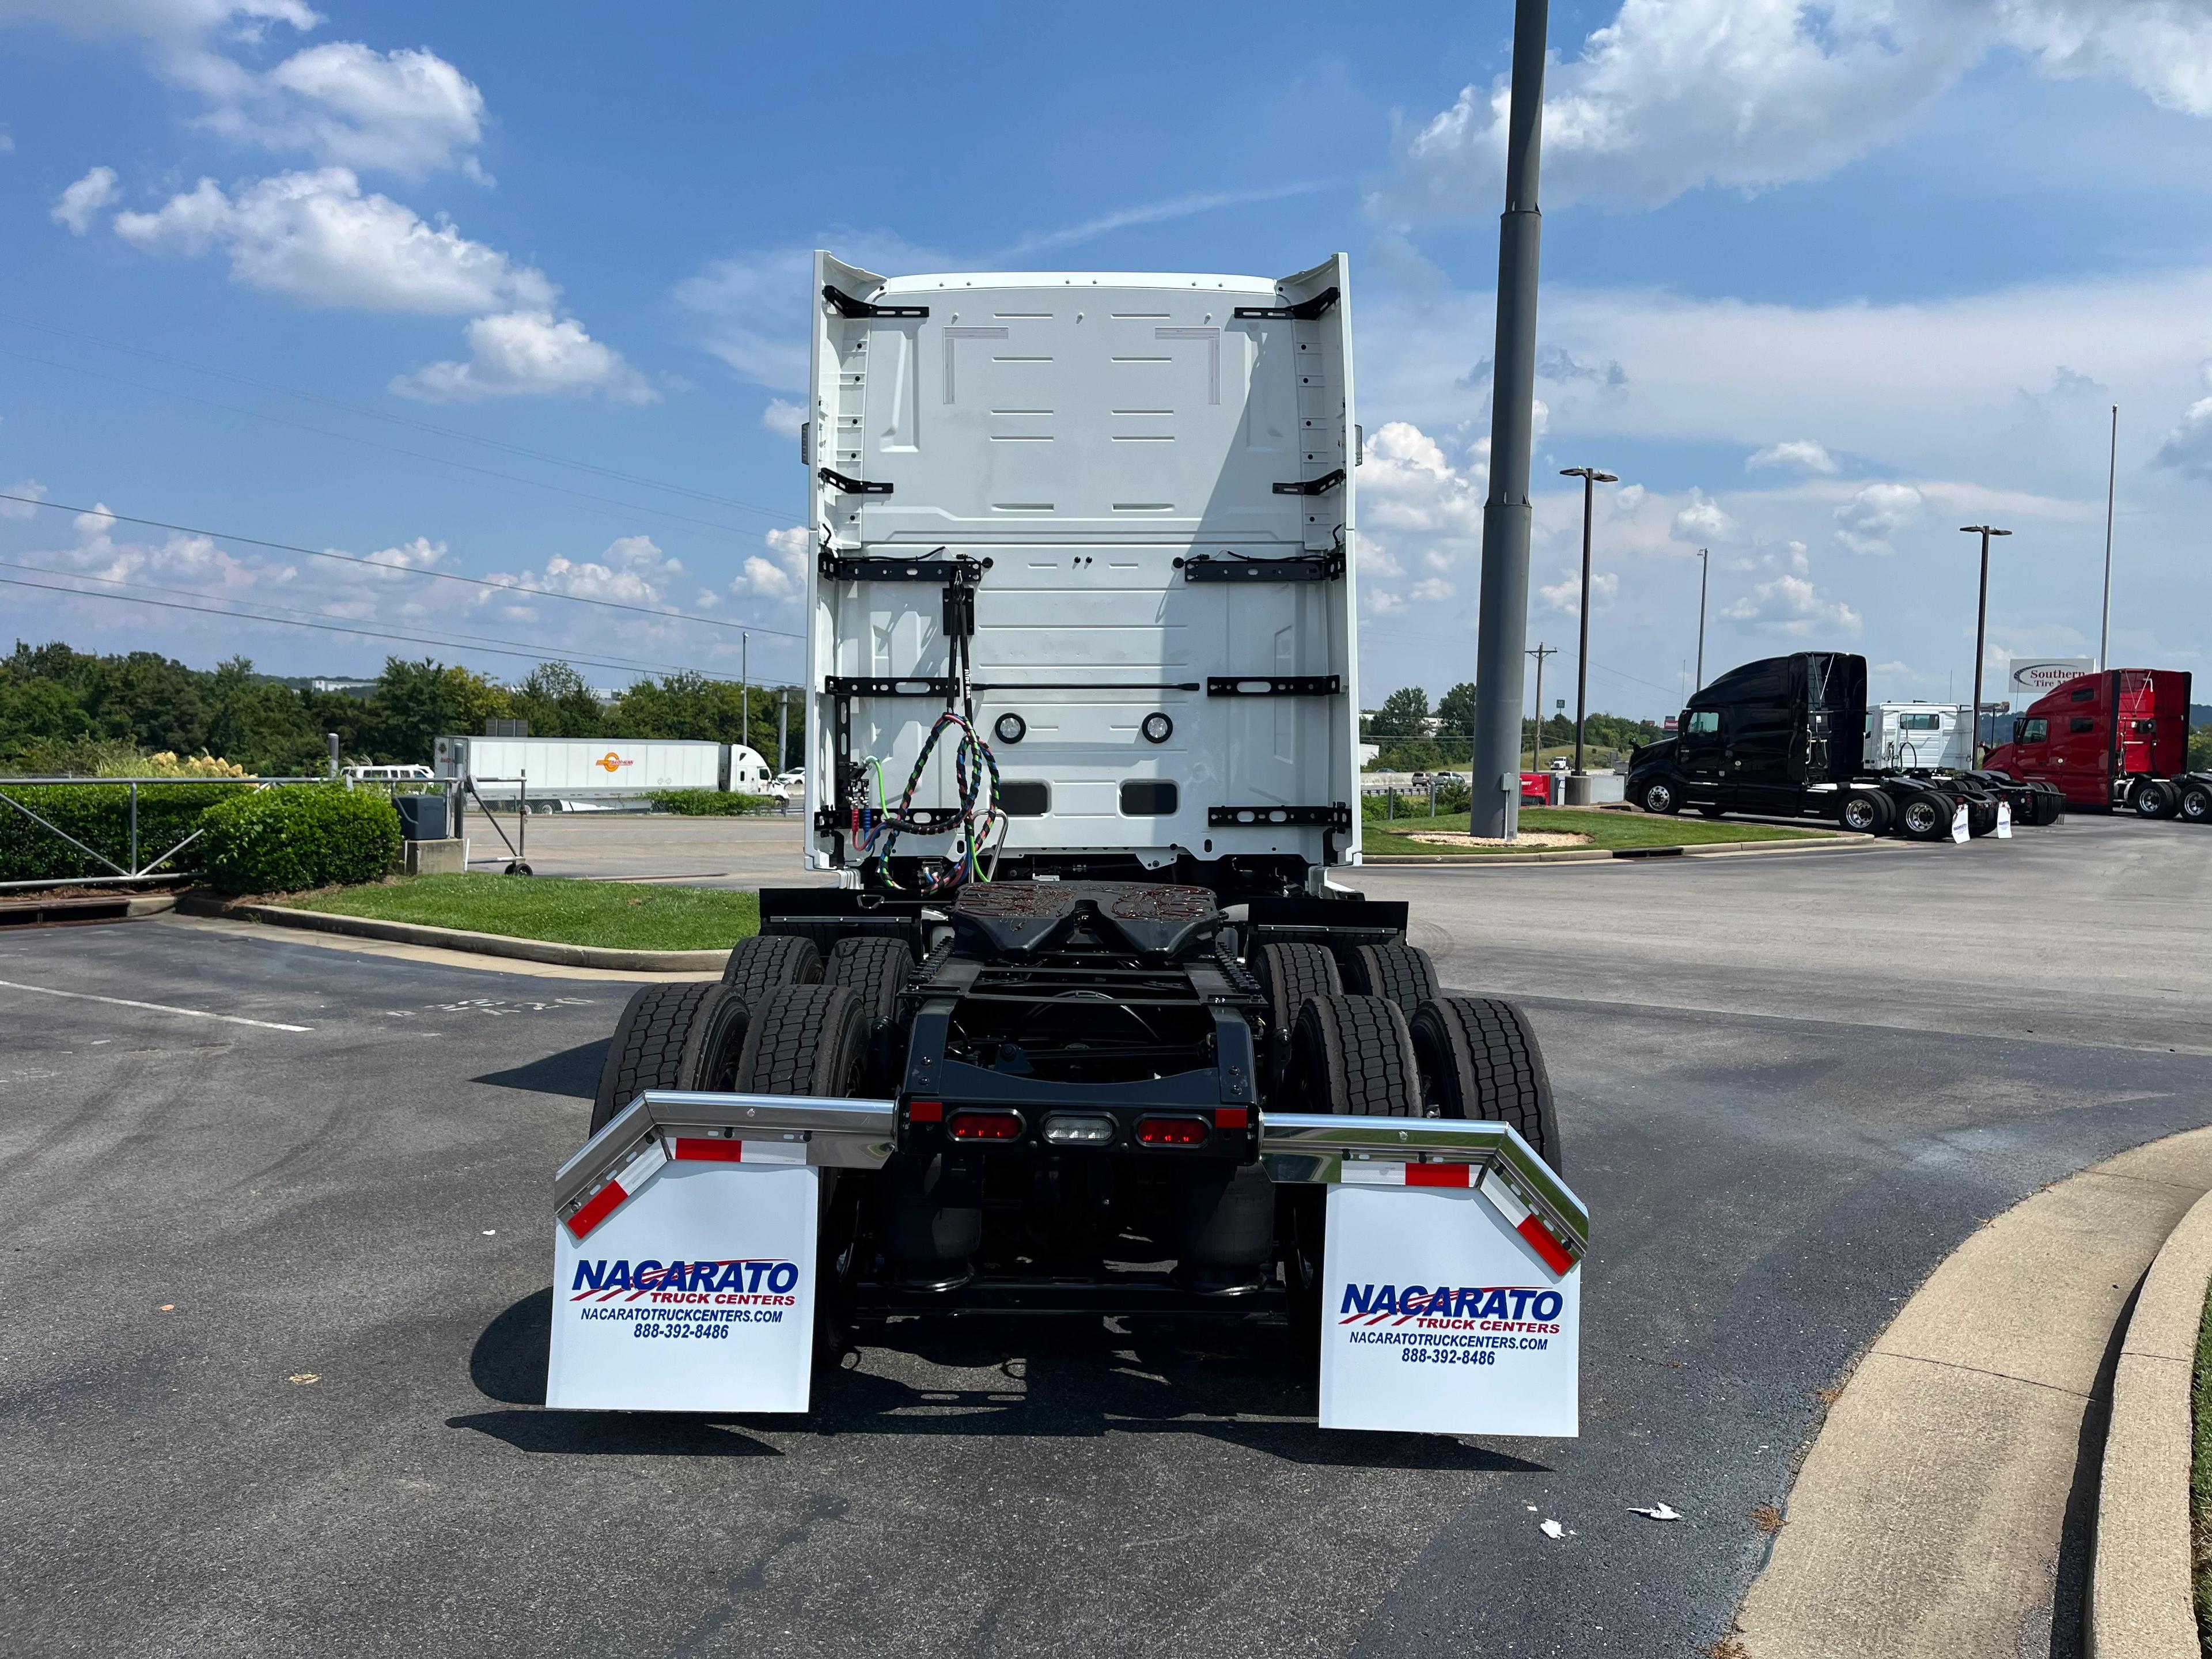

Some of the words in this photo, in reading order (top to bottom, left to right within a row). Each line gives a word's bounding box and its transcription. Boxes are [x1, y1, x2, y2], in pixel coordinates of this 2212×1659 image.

[2031, 669, 2085, 679] Southern
[571, 1259, 799, 1294] NACARATO
[650, 1292, 709, 1304] TRUCK
[715, 1294, 796, 1305] CENTERS
[1340, 1283, 1563, 1322] NACARATO
[581, 1308, 783, 1323] NACARATOTRUCKCENTERS.COM
[634, 1323, 729, 1339] 888-392-8486
[1416, 1317, 1475, 1330] TRUCK
[1480, 1321, 1560, 1334] CENTERS
[1350, 1331, 1548, 1350] NACARATOTRUCKCENTERS.COM
[1402, 1347, 1496, 1366] 888-392-8486
